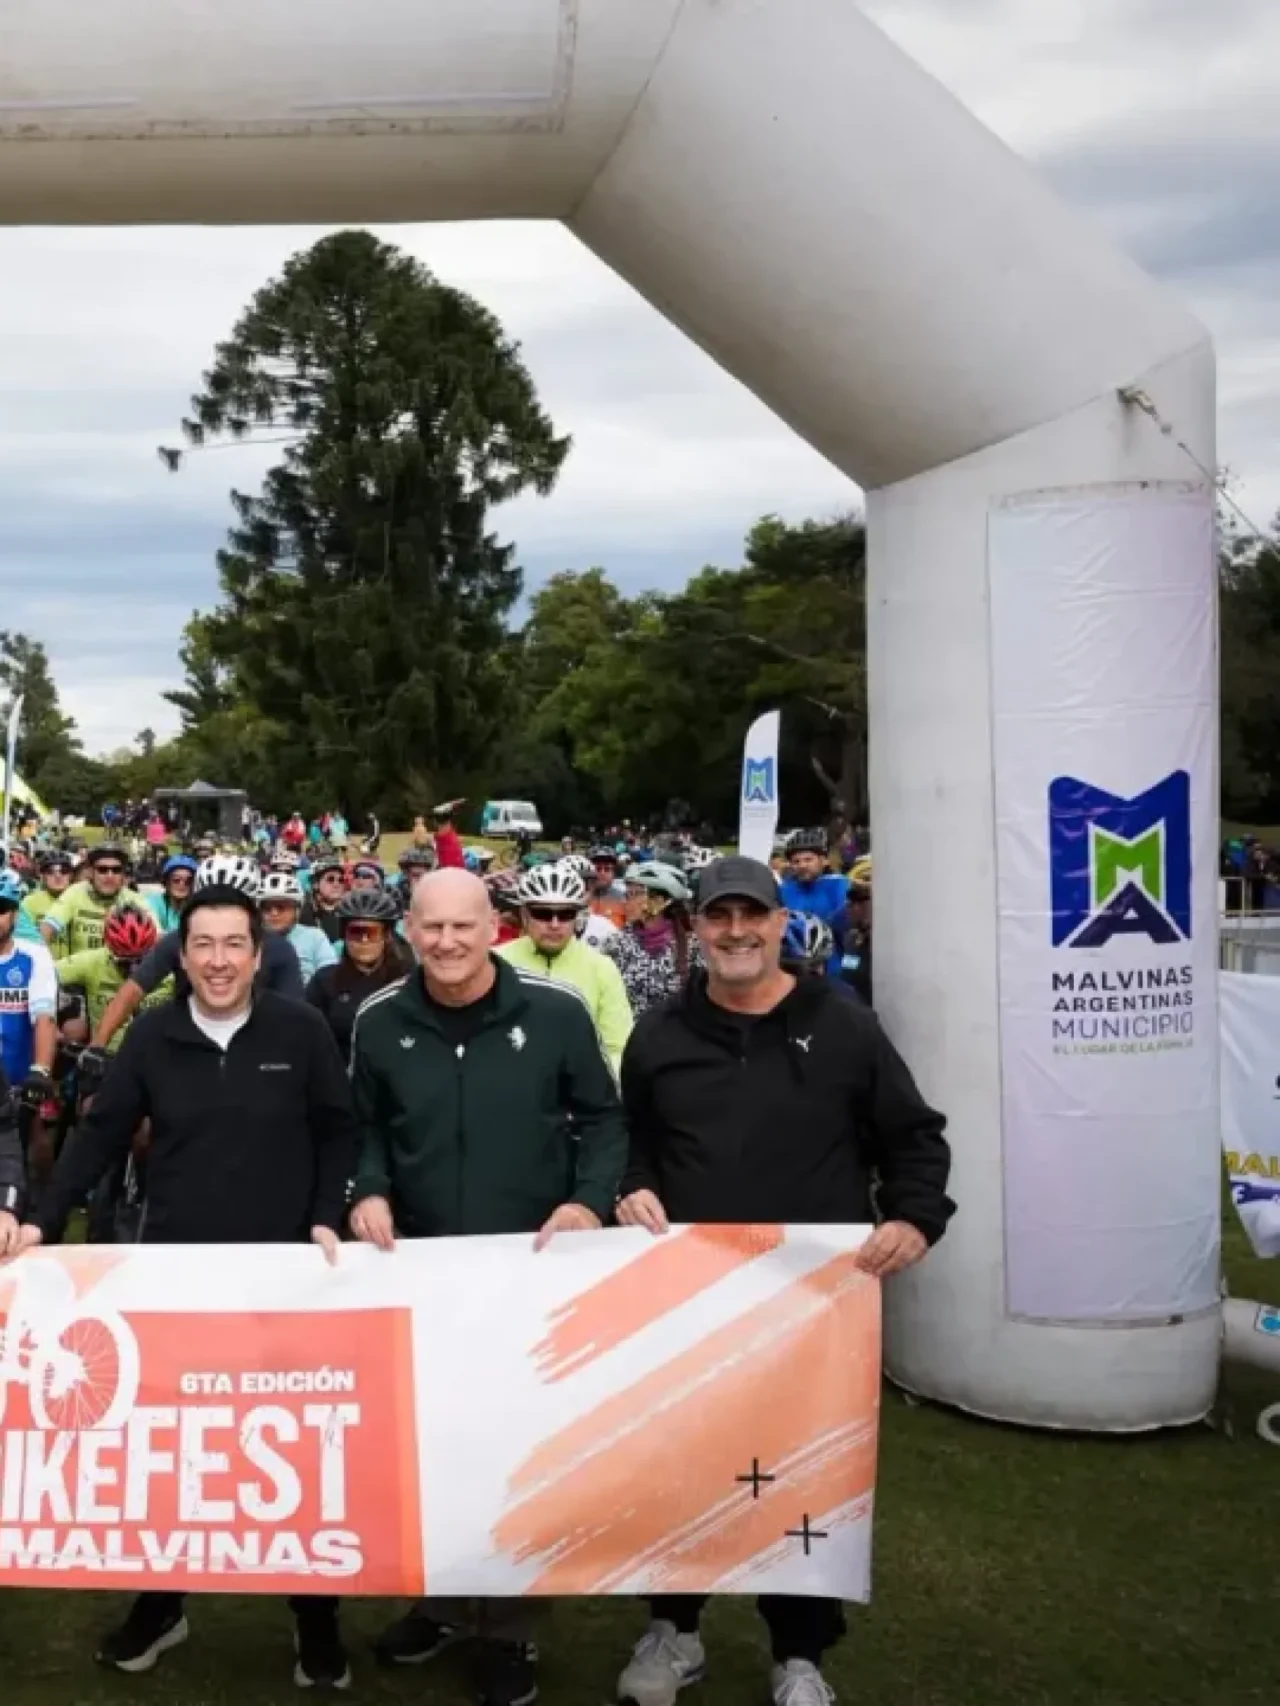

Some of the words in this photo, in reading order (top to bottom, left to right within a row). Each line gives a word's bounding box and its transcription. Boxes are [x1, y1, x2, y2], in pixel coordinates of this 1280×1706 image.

[1052, 965, 1193, 991] MALVINAS
[1052, 989, 1193, 1012] ARGENTINAS
[1052, 1011, 1193, 1039] MUNICIPIO
[179, 1372, 232, 1395] 6TA
[240, 1365, 355, 1393] EDICIÓN
